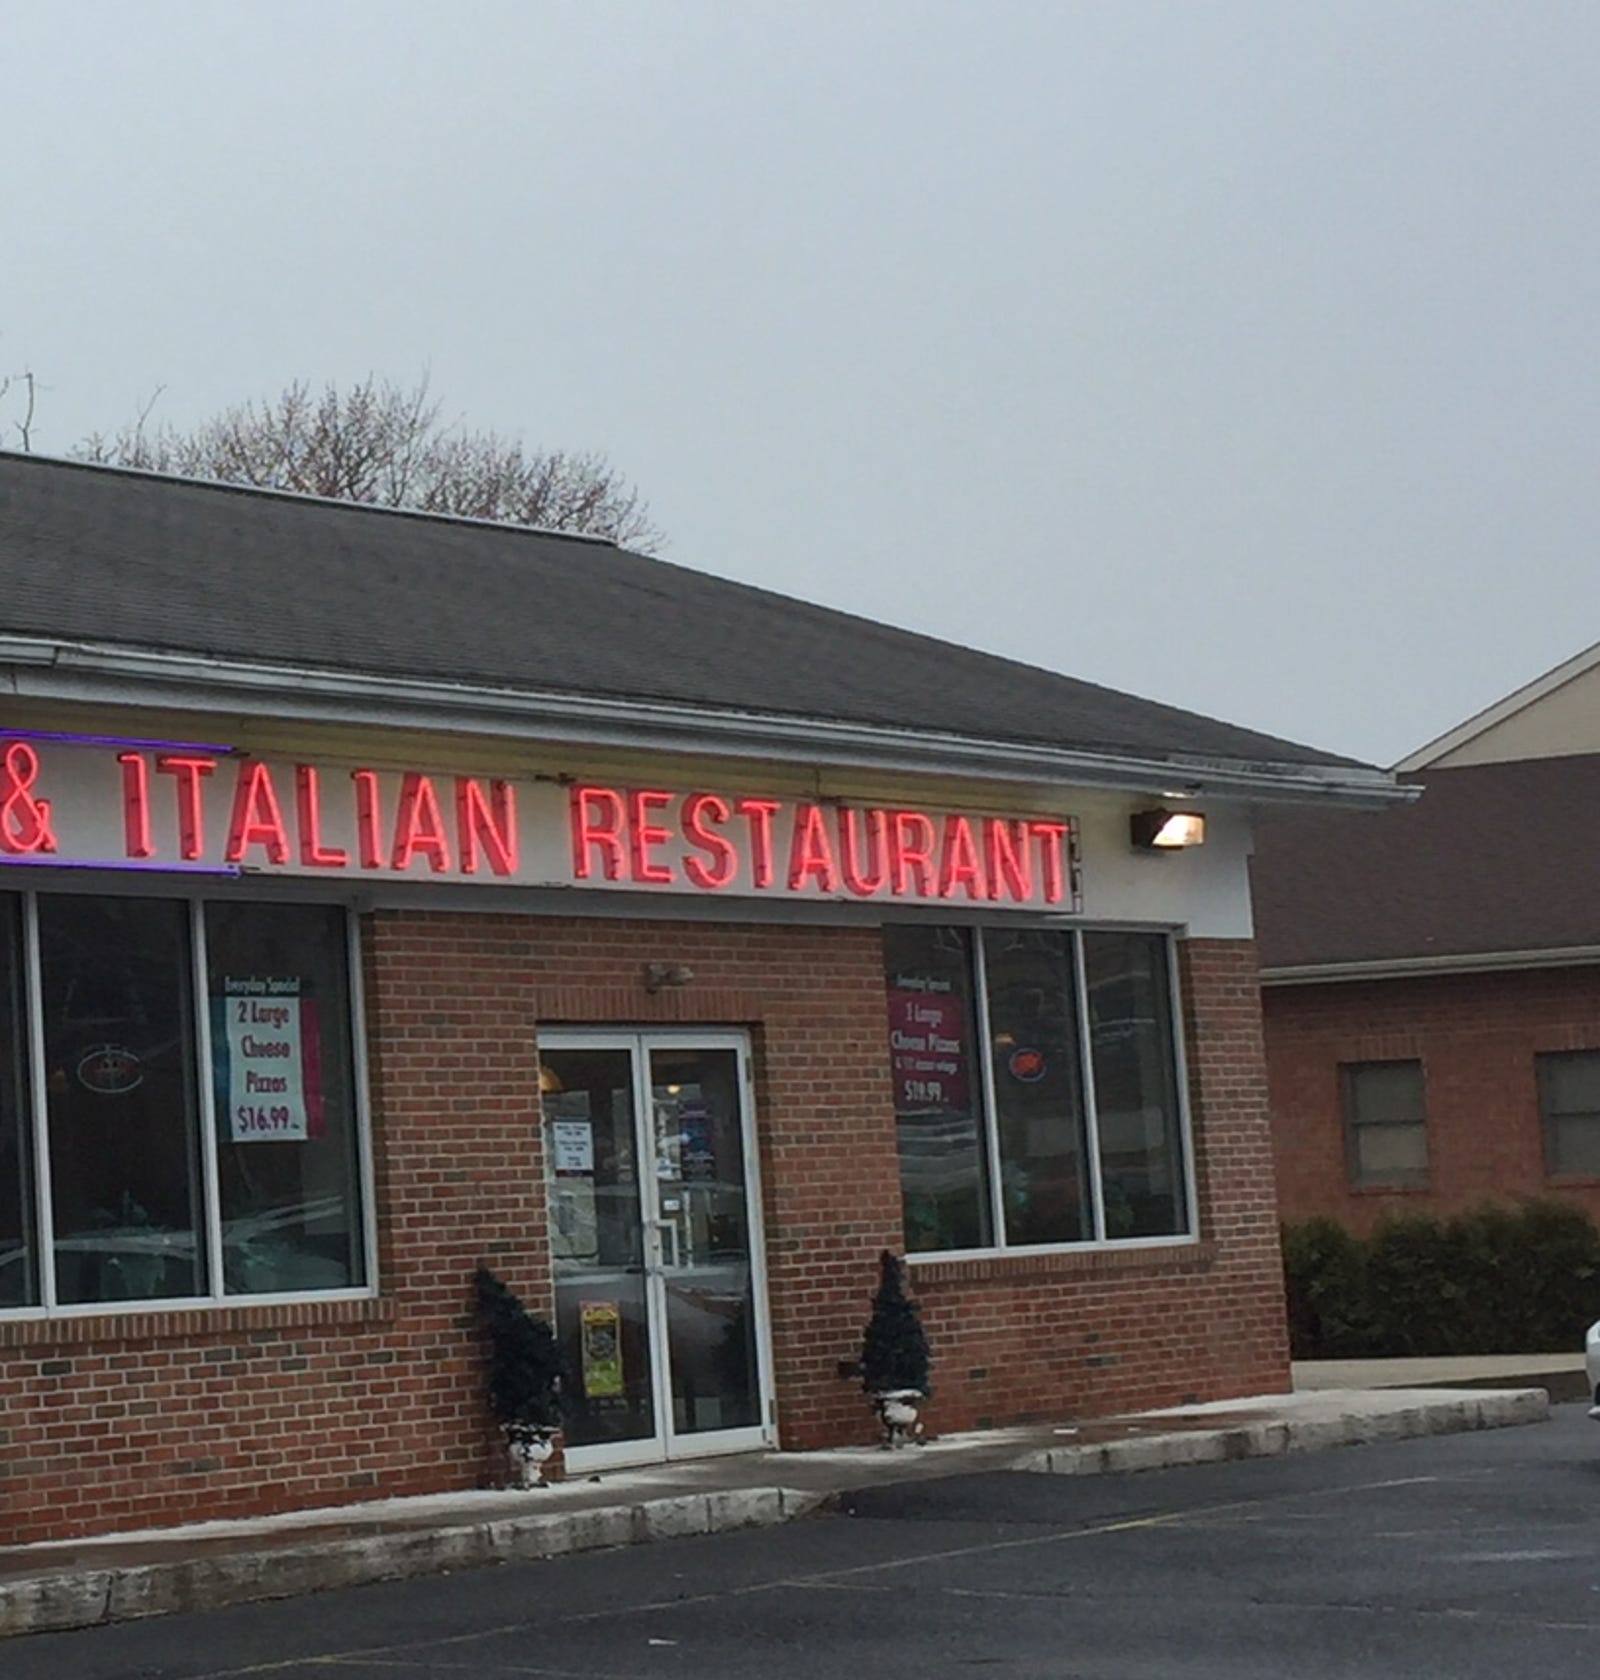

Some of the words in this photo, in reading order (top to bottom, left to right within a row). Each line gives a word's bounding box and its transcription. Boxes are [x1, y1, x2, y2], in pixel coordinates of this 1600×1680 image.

[117, 751, 518, 876] ITALIAN
[570, 784, 1069, 904] RESTAURANT
[237, 1001, 247, 1023] 2
[252, 1001, 290, 1028] Large
[914, 1003, 943, 1028] Large
[241, 1035, 291, 1058] Cheese
[246, 1070, 287, 1093] Pizzas
[237, 1105, 290, 1132] $16.99
